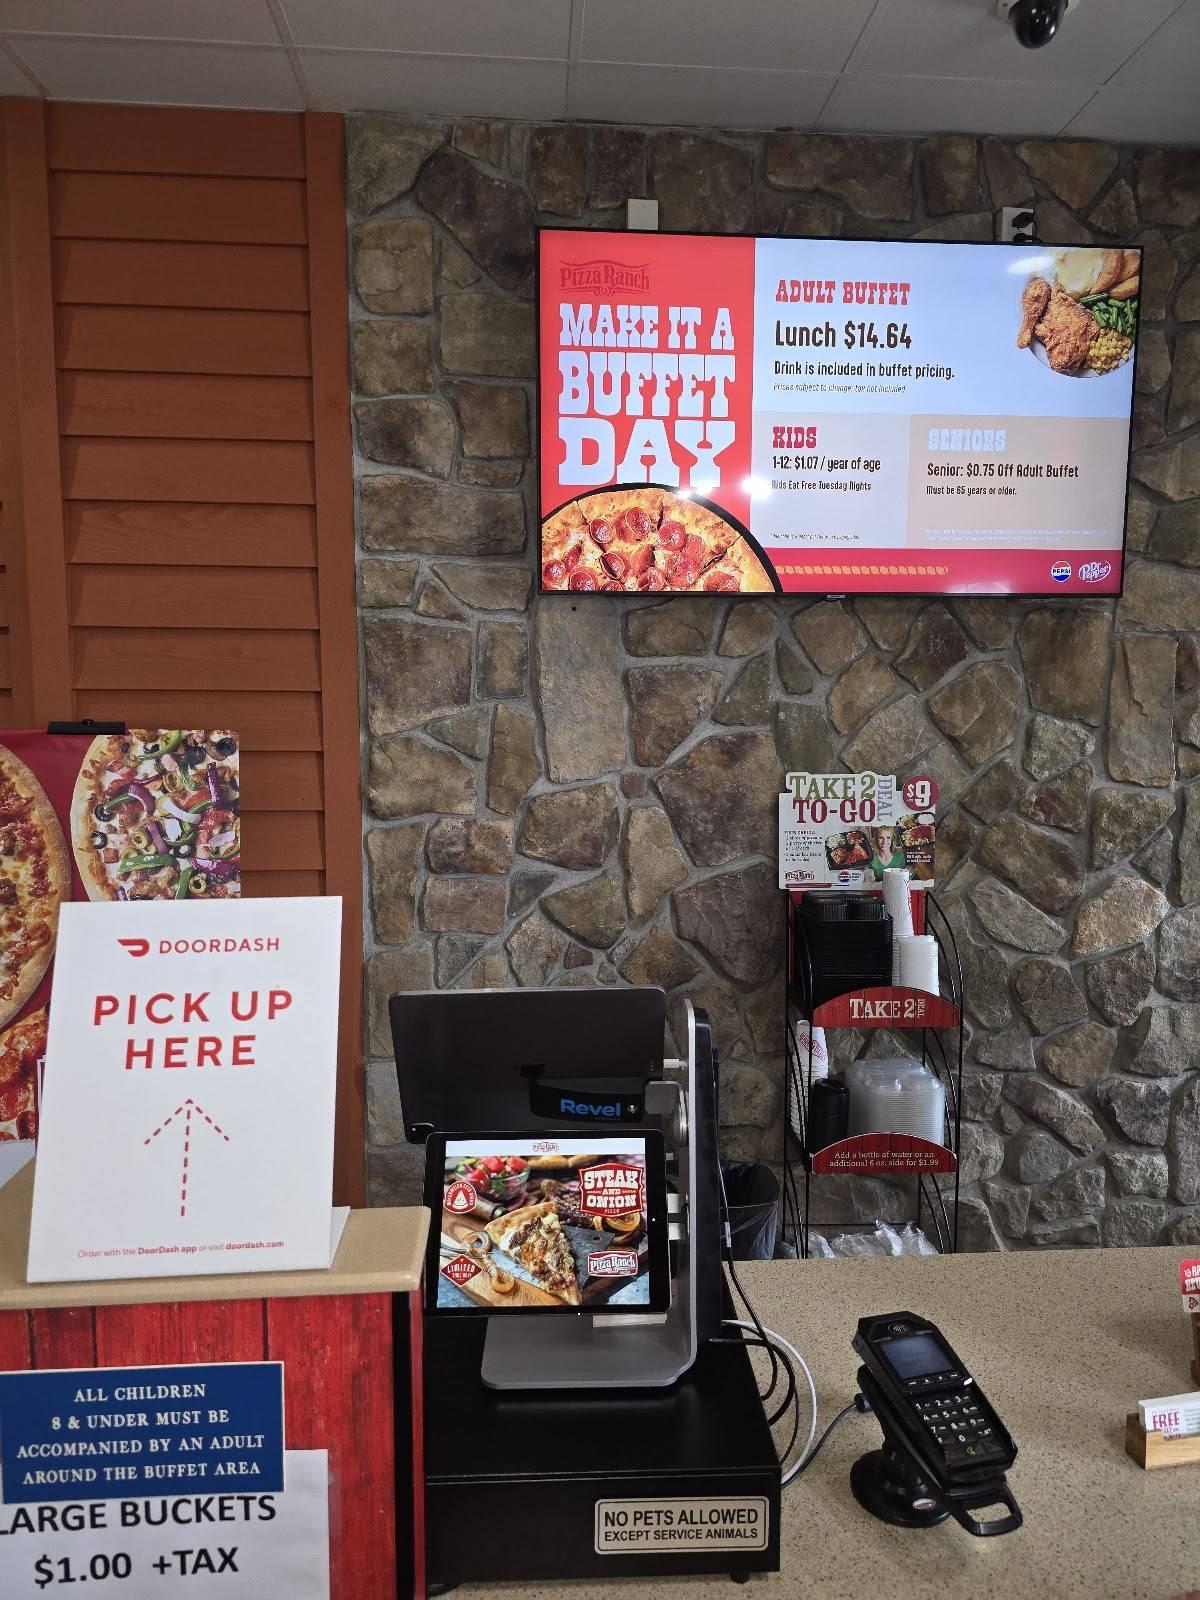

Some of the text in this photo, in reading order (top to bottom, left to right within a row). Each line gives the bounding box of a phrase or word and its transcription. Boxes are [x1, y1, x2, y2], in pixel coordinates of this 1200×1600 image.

[560, 265, 650, 290] Pizza Ranch
[775, 279, 911, 305] ADULT BUFFET
[559, 303, 735, 350] MAKE IT A
[775, 320, 912, 349] Lunch $14.64
[774, 361, 955, 380] Drink is included in buffet pricing.
[558, 351, 736, 418] BUFFET
[772, 426, 817, 449] KIDS
[928, 428, 1008, 452] SENIORS
[558, 417, 736, 488] DAY
[772, 455, 881, 473] 1-12: $1.07 / year of age
[927, 462, 1079, 478] Senior: $0.75 Off Adult Buffet
[772, 479, 872, 492] Kids Eat Free Tuesday Nights
[926, 486, 1017, 497] Must be 65 years or older.
[1082, 564, 1110, 581] Pepper
[1090, 561, 1102, 571] Dr
[789, 774, 876, 800] TAKE 2
[906, 780, 931, 807] $9
[876, 777, 893, 822] DEAL
[792, 799, 876, 824] TO-GO
[159, 938, 280, 954] DOORDASH
[93, 989, 293, 1026] PICK UP
[849, 998, 915, 1019] TAKE 2
[125, 1034, 256, 1070] HERE
[560, 1098, 621, 1117] Revel
[858, 1151, 880, 1159] bottle
[918, 1159, 939, 1167] $1.99
[584, 1169, 639, 1190] STEAK
[586, 1194, 637, 1209] ONION
[77, 1248, 103, 1259] Order
[104, 1248, 121, 1257] with
[122, 1247, 137, 1257] the
[138, 1246, 180, 1255] DoorDash
[181, 1246, 198, 1255] app
[209, 1243, 224, 1251] visit
[225, 1240, 285, 1251] doordash.com
[447, 1264, 476, 1274] LIMITED
[590, 1255, 636, 1272] Pizza Ranch
[74, 1383, 206, 1402] ALL CHILDREN
[954, 1395, 961, 1403] 3
[52, 1409, 229, 1430] 8 & UNDER MUST BE
[942, 1410, 950, 1418] 5
[1152, 1411, 1180, 1429] FREE
[930, 1418, 976, 1434] 7 8 9
[16, 1434, 265, 1458] ACCOMPANIED BY AN ADULT
[958, 1434, 966, 1442] 0
[23, 1460, 261, 1485] AROUND THE BUFFET AREA
[120, 1494, 277, 1528] BUCKETS
[604, 1508, 759, 1527] NO PETS ALLOWED
[604, 1527, 758, 1542] EXCEPT SERVICE ANIMALS
[34, 1546, 240, 1590] $1.00 +TAX
